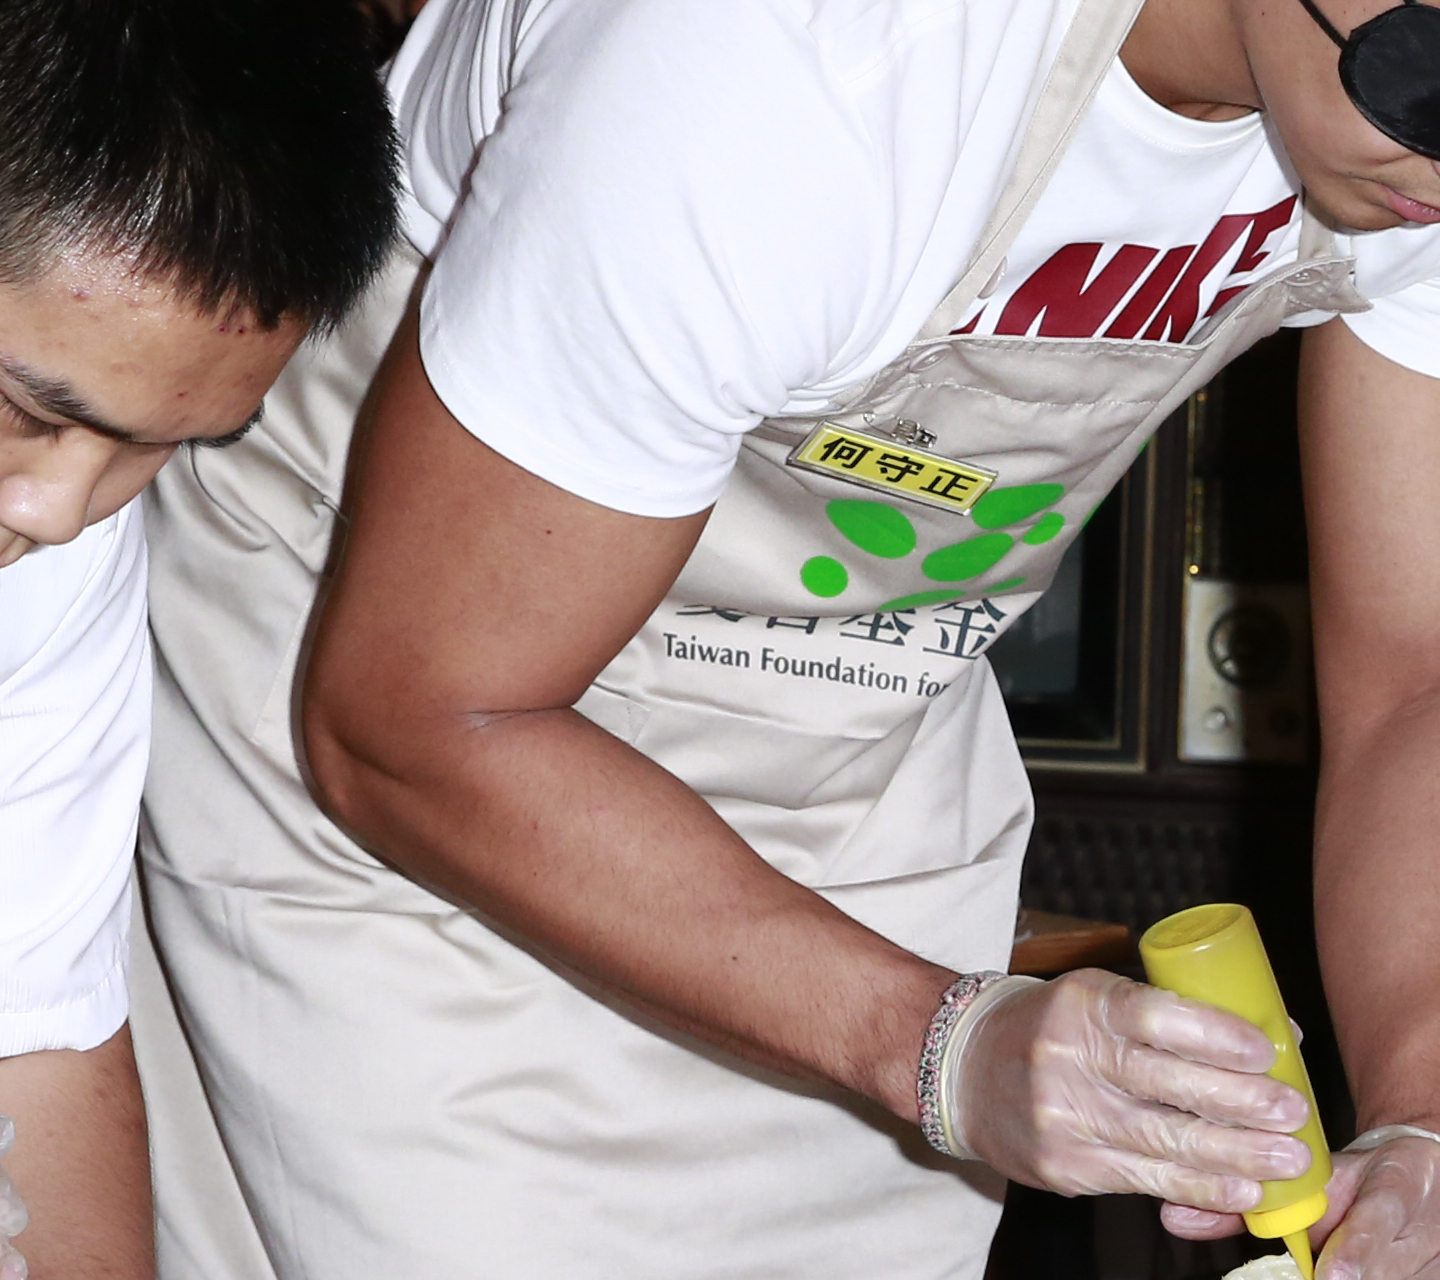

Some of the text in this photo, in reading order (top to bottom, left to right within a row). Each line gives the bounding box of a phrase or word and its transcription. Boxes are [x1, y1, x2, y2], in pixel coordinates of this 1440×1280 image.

[818, 436, 979, 502] 何守正
[662, 632, 752, 669] Taiwan
[760, 646, 909, 695] Foundation
